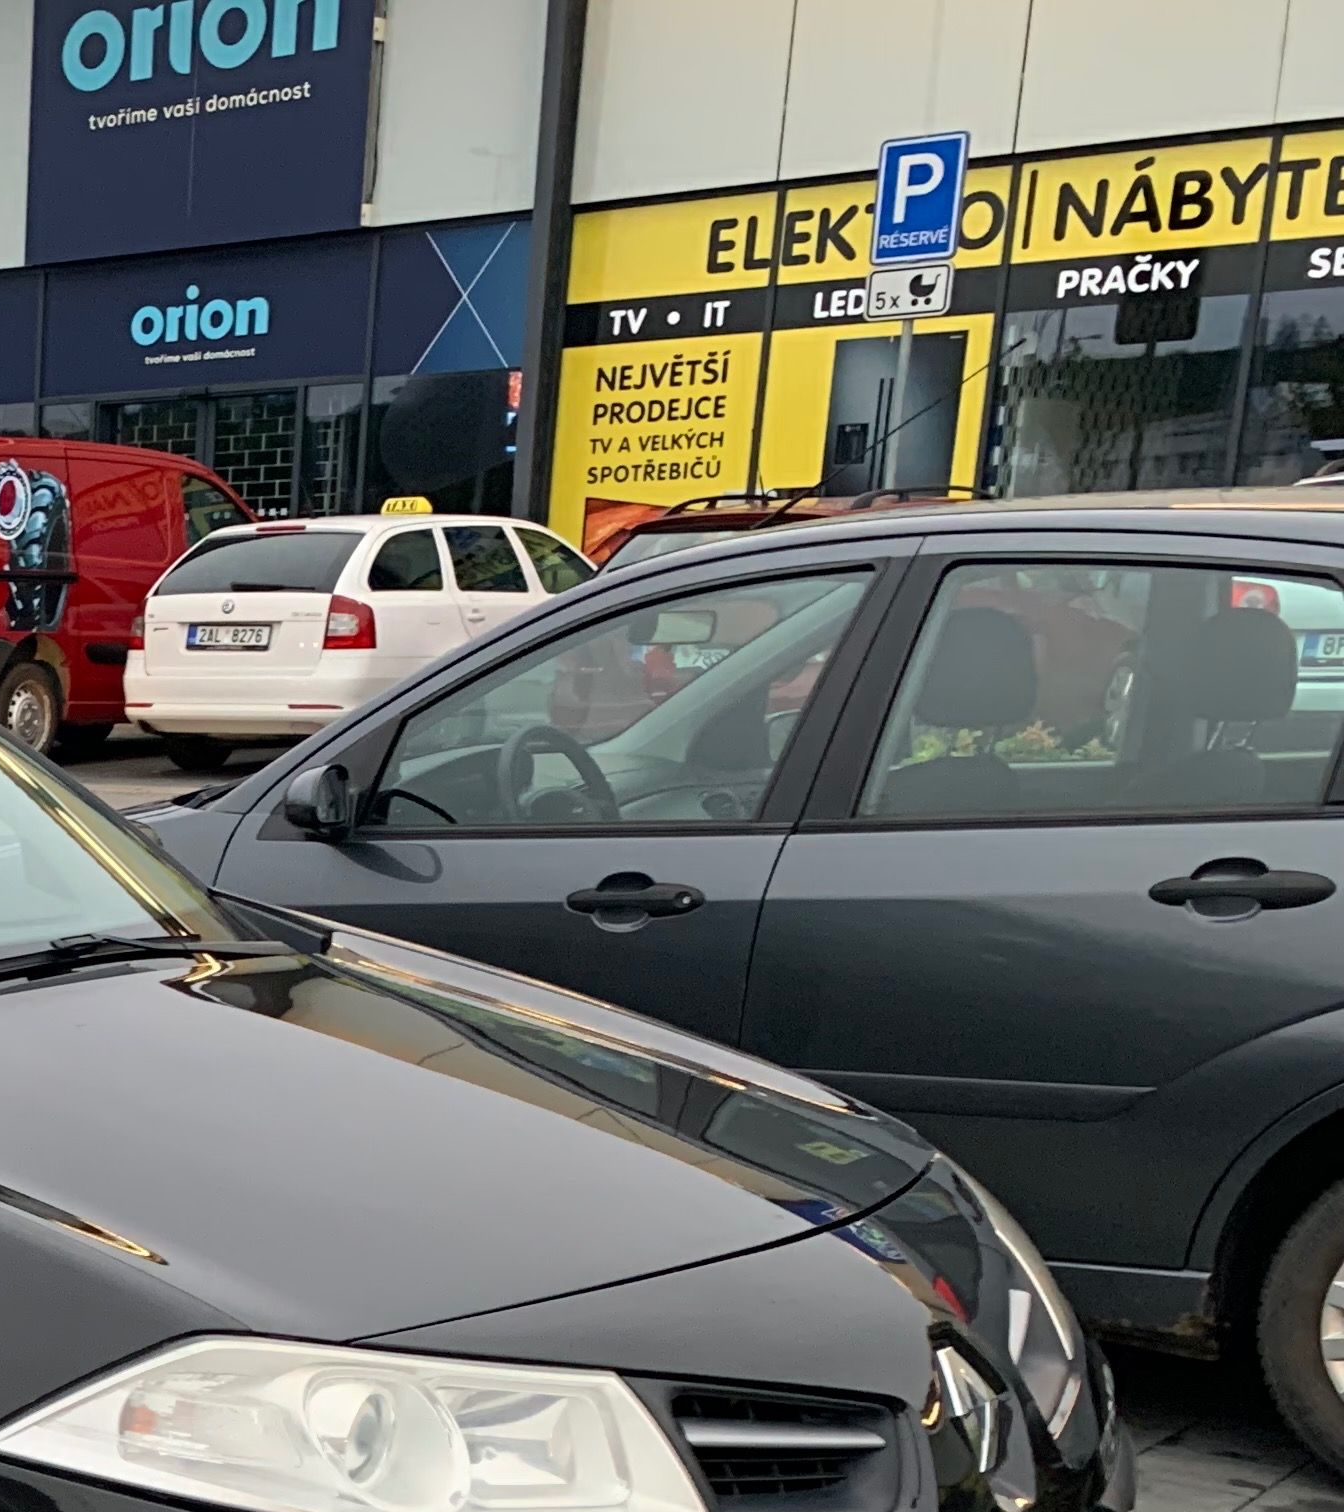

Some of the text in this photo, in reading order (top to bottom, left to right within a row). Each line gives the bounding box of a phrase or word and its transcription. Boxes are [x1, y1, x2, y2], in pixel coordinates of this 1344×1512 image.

[62, 0, 341, 92] orion
[88, 107, 158, 131] tvoříme
[205, 81, 312, 112] domácnost
[892, 153, 945, 224] P
[707, 190, 1005, 274] ELEKO
[878, 225, 950, 250] RÉSERVÉ
[131, 284, 270, 346] orion
[609, 307, 648, 336] TV
[703, 300, 731, 328] IT
[1056, 253, 1200, 299] PRAČKY
[596, 349, 732, 392] NEJVĚTŠÍ
[592, 395, 727, 425] PRODEJCE
[589, 428, 725, 454] TV A VELKÝCH
[587, 454, 721, 484] SPOTŘEBIČŮ
[199, 629, 220, 643] 2AL
[232, 628, 263, 643] 8276
